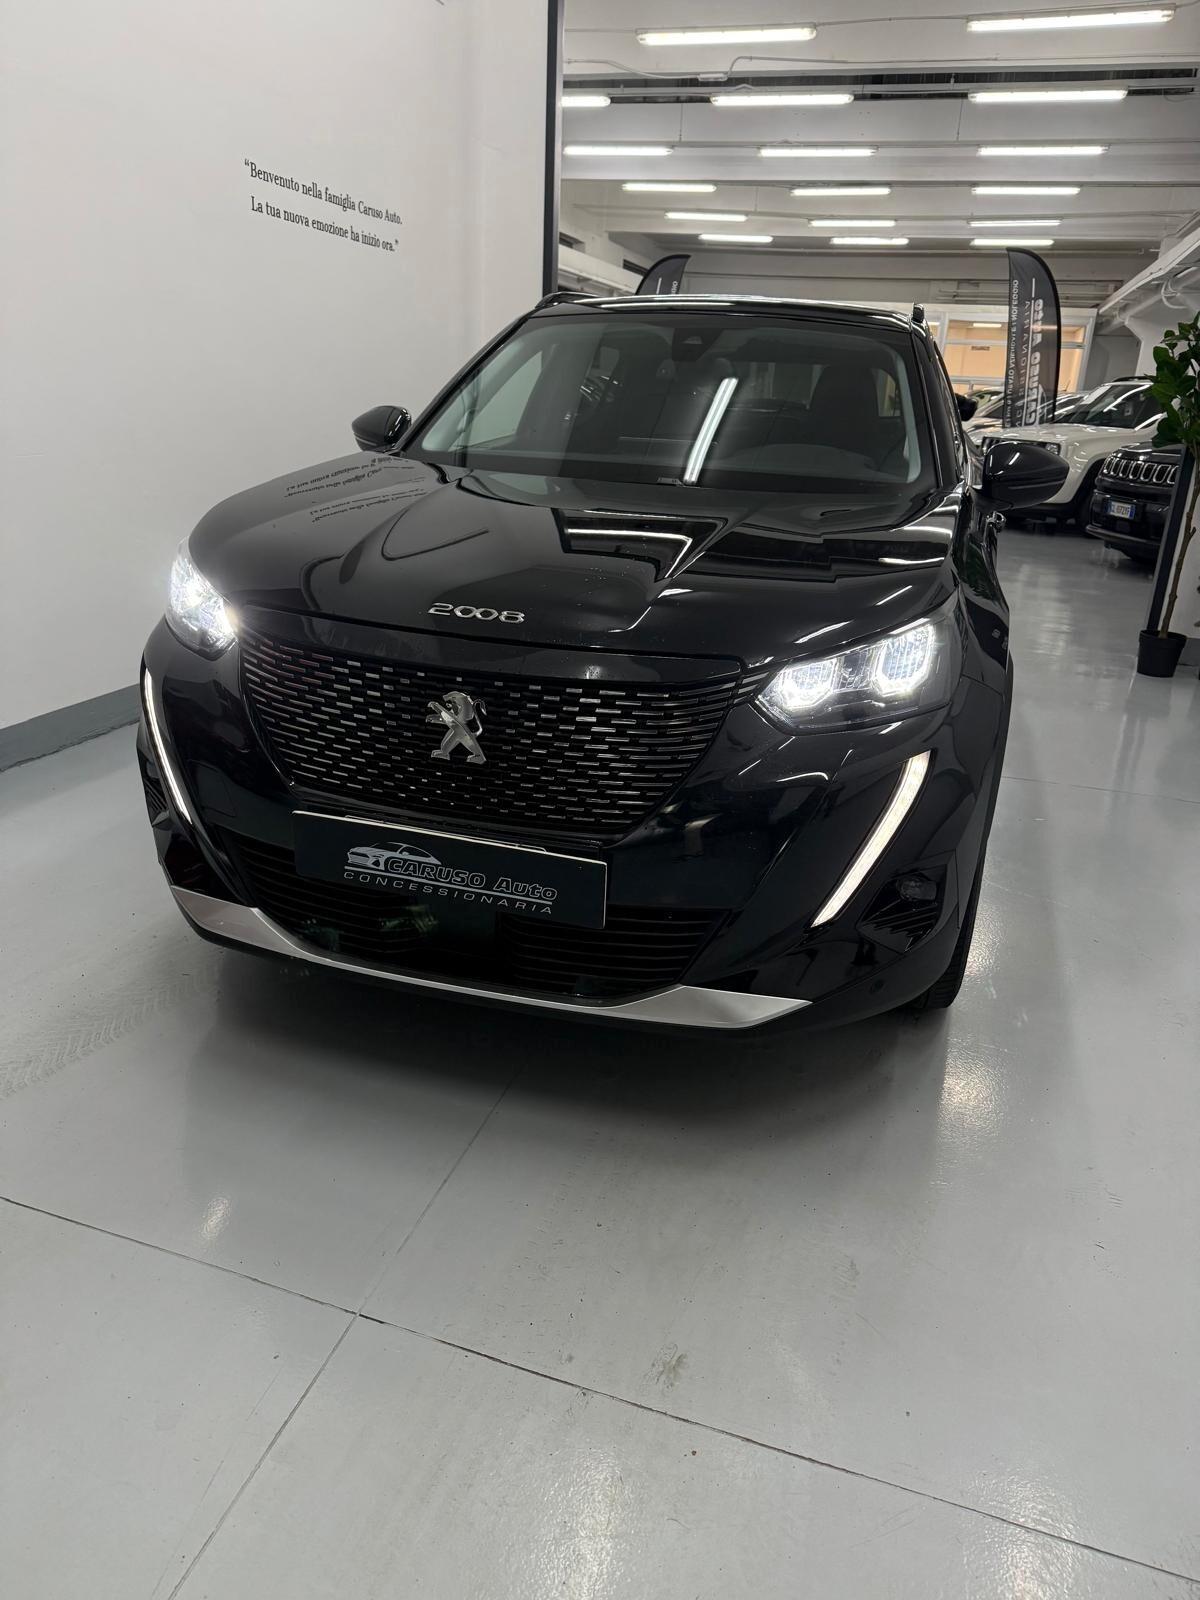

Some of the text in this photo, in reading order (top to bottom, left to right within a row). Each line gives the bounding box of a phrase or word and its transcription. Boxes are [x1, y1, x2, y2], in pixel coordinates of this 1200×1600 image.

[244, 158, 403, 225] “Benvenuto nella famiglia Caruso Auto.
[251, 195, 264, 213] La
[265, 201, 282, 219] tua
[283, 209, 310, 227] nuova
[311, 218, 349, 239] emozione
[350, 225, 360, 242] ha
[361, 229, 381, 248] inizio
[427, 602, 525, 623] 2008
[343, 871, 552, 914] CONCESSIONARIA
[388, 858, 558, 900] CARUSO Auto
